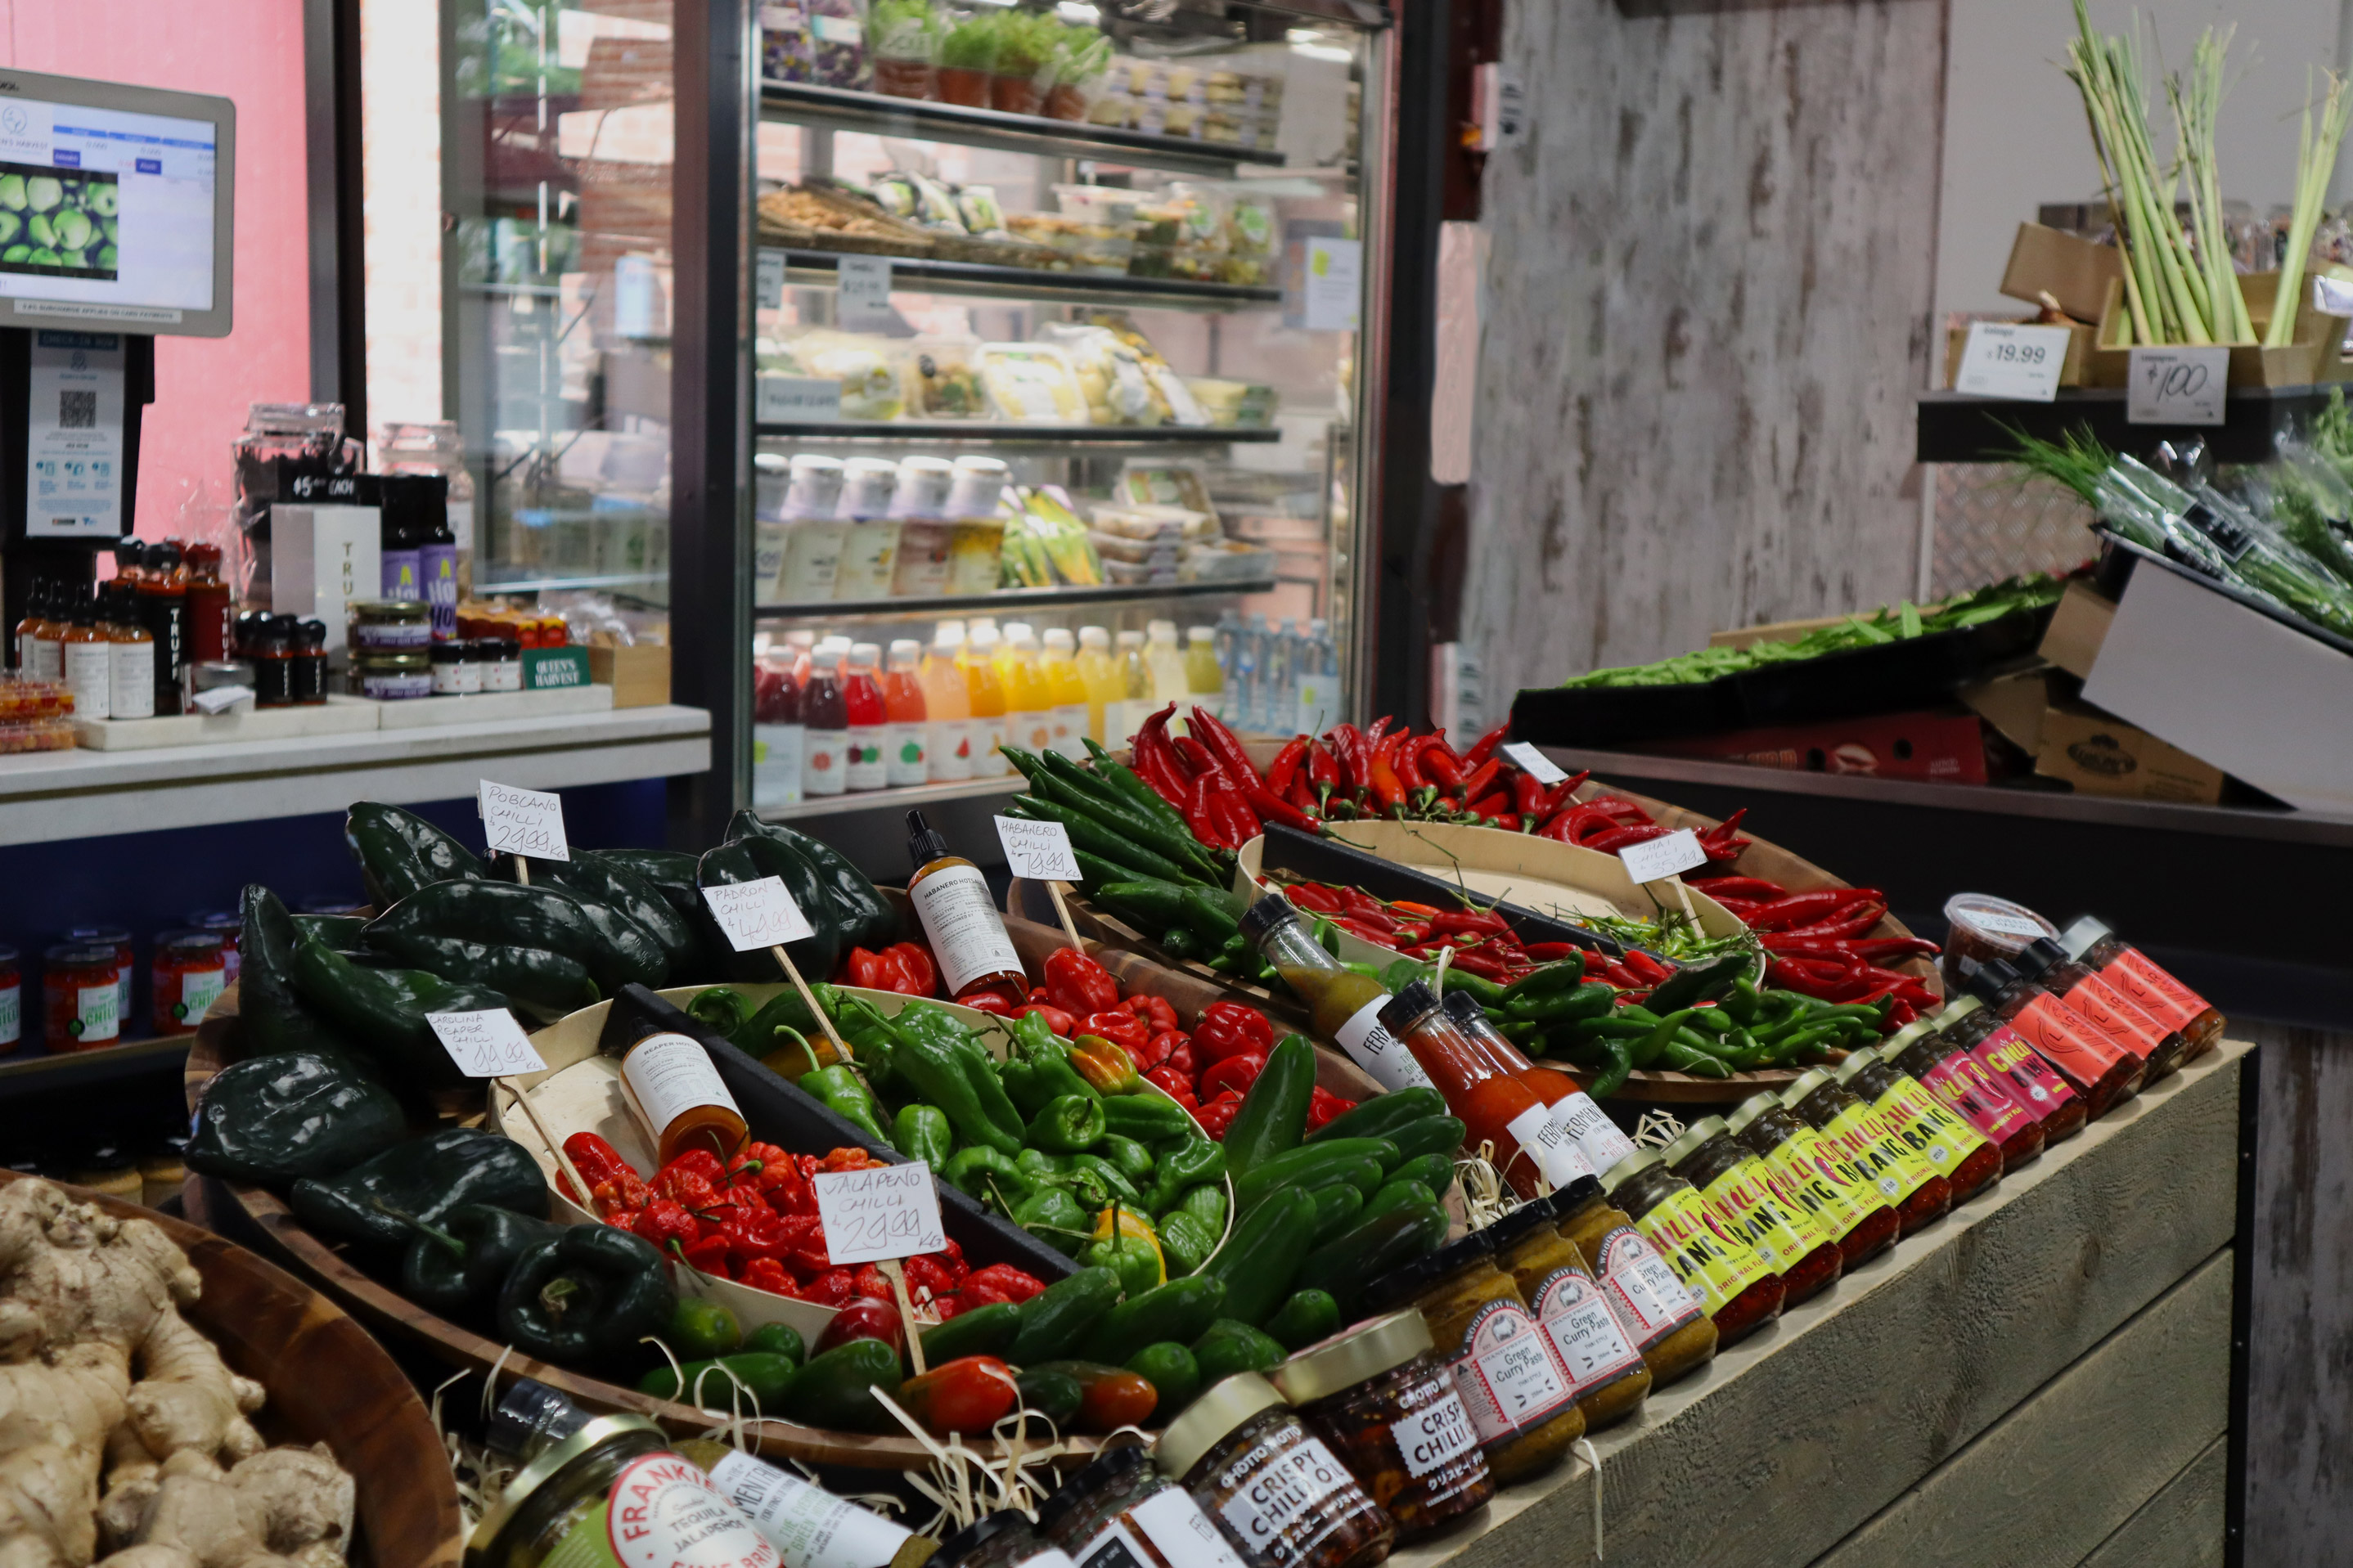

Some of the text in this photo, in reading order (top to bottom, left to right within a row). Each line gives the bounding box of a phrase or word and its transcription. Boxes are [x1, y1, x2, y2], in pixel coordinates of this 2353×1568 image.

[535, 671, 579, 686] HARVEST
[488, 785, 556, 811] POBLANO
[491, 806, 543, 827] CHILLI
[1001, 821, 1058, 838] HABANERO
[1009, 836, 1051, 851] CHILLI
[1632, 847, 1677, 864] CHILLI
[1640, 838, 1670, 852] THAI
[713, 881, 768, 901] PADRON
[924, 879, 959, 900] HABANERO
[721, 899, 767, 914] CHILLI
[430, 1013, 484, 1024] CAROLINA
[437, 1025, 484, 1036] REAPER
[452, 1036, 493, 1044] CHILLI
[644, 1042, 674, 1056] REAPER
[1902, 1108, 1955, 1151] BANG
[1853, 1138, 1910, 1181] BANG
[823, 1167, 920, 1196] JALAPENO
[839, 1193, 902, 1212] CHILLI
[1829, 1205, 1866, 1236] ORIGINAL
[919, 1231, 943, 1248] KG
[1600, 1226, 1629, 1265] WOOLAWAY
[1783, 1230, 1817, 1256] ORIGINAL
[1533, 1268, 1570, 1309] WOOLAWAY
[1632, 1269, 1671, 1294] Cury Paste
[1716, 1265, 1753, 1293] ORIGINAL
[1465, 1301, 1504, 1343] WOOLAWAY
[1563, 1316, 1610, 1346] Curry Paste
[1571, 1311, 1597, 1329] Green
[1496, 1352, 1545, 1383] Curry Paste
[1505, 1346, 1532, 1365] Green
[1414, 1423, 1467, 1464] CHILLI
[1221, 1447, 1267, 1489] CHOTTO
[1251, 1449, 1318, 1505] CRISPY
[1251, 1462, 1344, 1537] CHILLI OIL
[668, 1507, 727, 1533] TEQUILA
[780, 1517, 799, 1538] THE
[790, 1518, 817, 1552] GREEN
